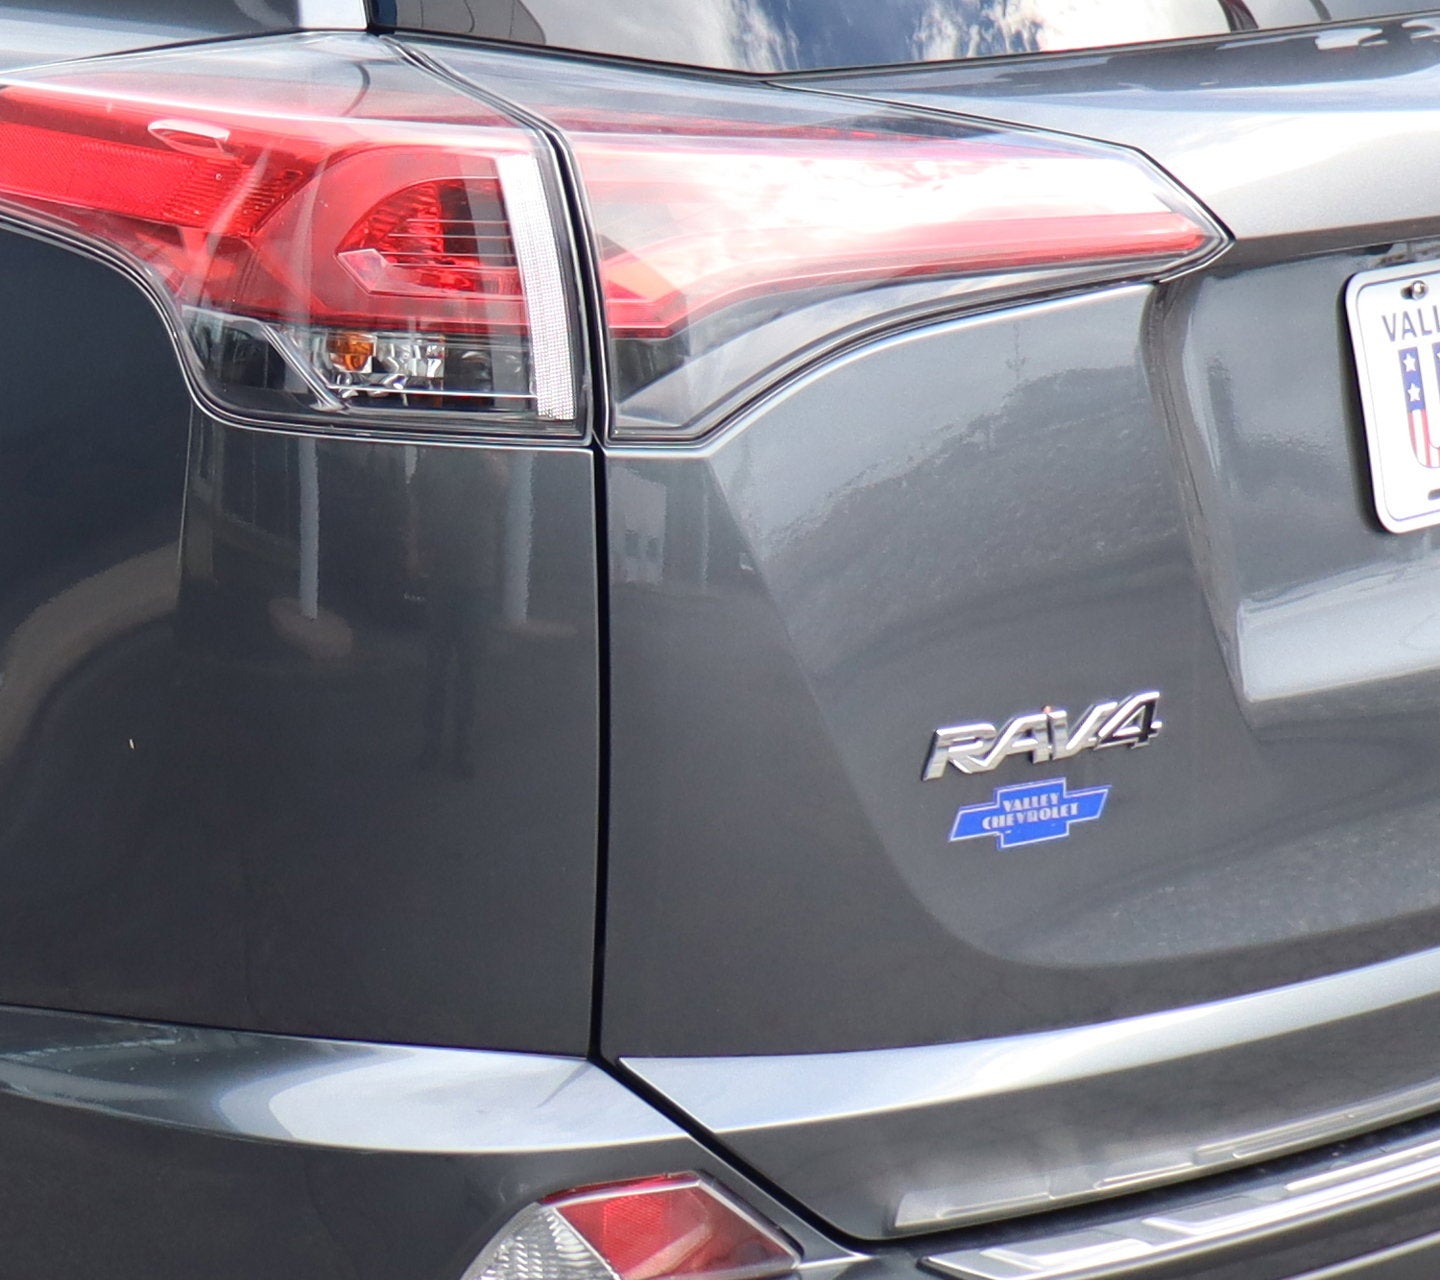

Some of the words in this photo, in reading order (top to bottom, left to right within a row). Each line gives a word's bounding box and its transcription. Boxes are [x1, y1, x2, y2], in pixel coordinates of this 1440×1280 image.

[921, 690, 1163, 782] RAV4
[981, 802, 1080, 831] CHEVROLET
[1002, 791, 1060, 813] VALLEY
